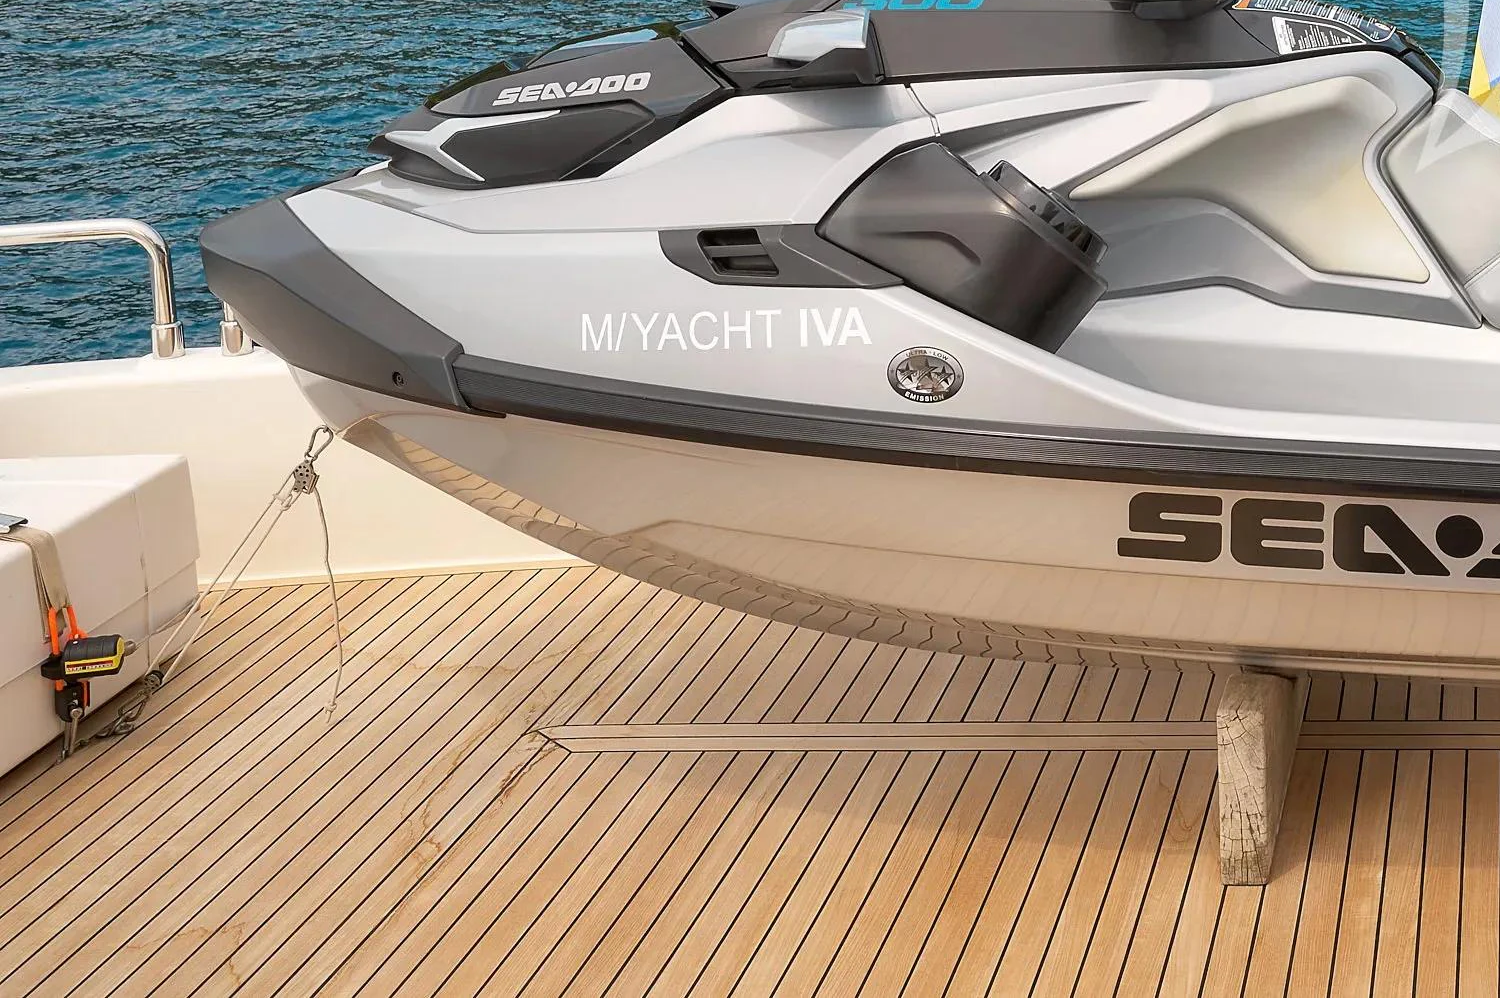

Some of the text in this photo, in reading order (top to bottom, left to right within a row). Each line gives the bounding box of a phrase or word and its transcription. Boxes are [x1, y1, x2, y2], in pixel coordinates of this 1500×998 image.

[581, 306, 872, 352] M/YACHT IVA
[932, 352, 949, 361] LOW
[904, 391, 945, 402] EMISSION
